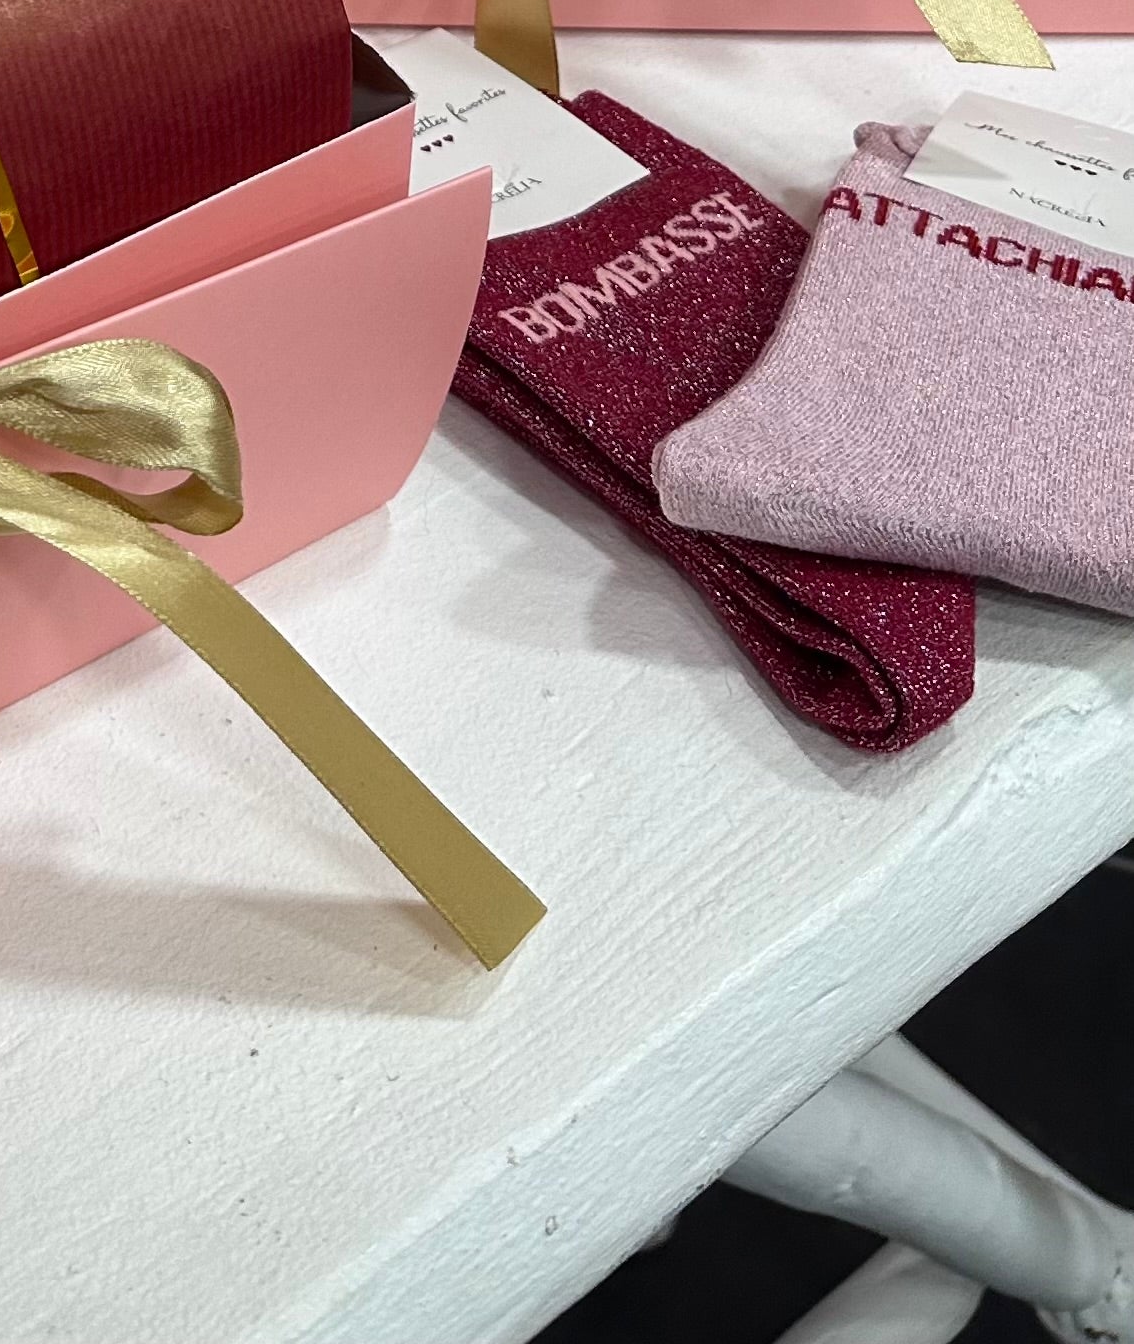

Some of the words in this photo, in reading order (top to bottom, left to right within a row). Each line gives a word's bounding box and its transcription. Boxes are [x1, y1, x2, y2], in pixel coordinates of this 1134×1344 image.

[445, 88, 506, 123] favorites
[497, 191, 765, 345] BOMBASSE
[823, 186, 1134, 304] ATTACHIA
